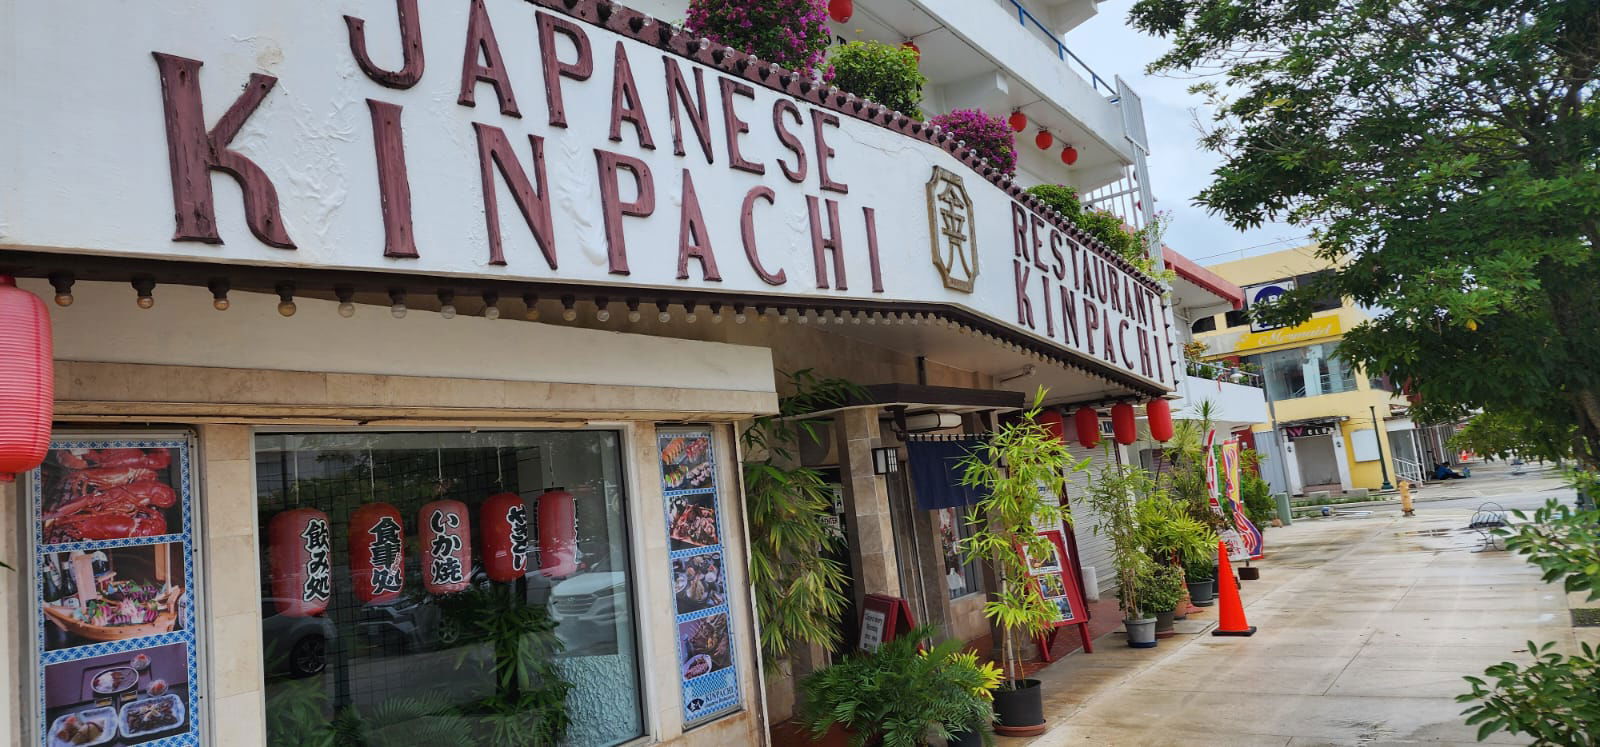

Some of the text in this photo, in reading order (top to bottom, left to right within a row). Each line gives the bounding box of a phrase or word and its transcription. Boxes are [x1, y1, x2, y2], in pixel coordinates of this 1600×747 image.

[343, 0, 849, 195] JAPANESE
[151, 51, 884, 294] KINPACHI
[1011, 201, 1158, 332] RESTAURANT
[1013, 259, 1165, 383] KINPACHI
[301, 519, 330, 601] 飲み処
[430, 509, 463, 585] いか焼
